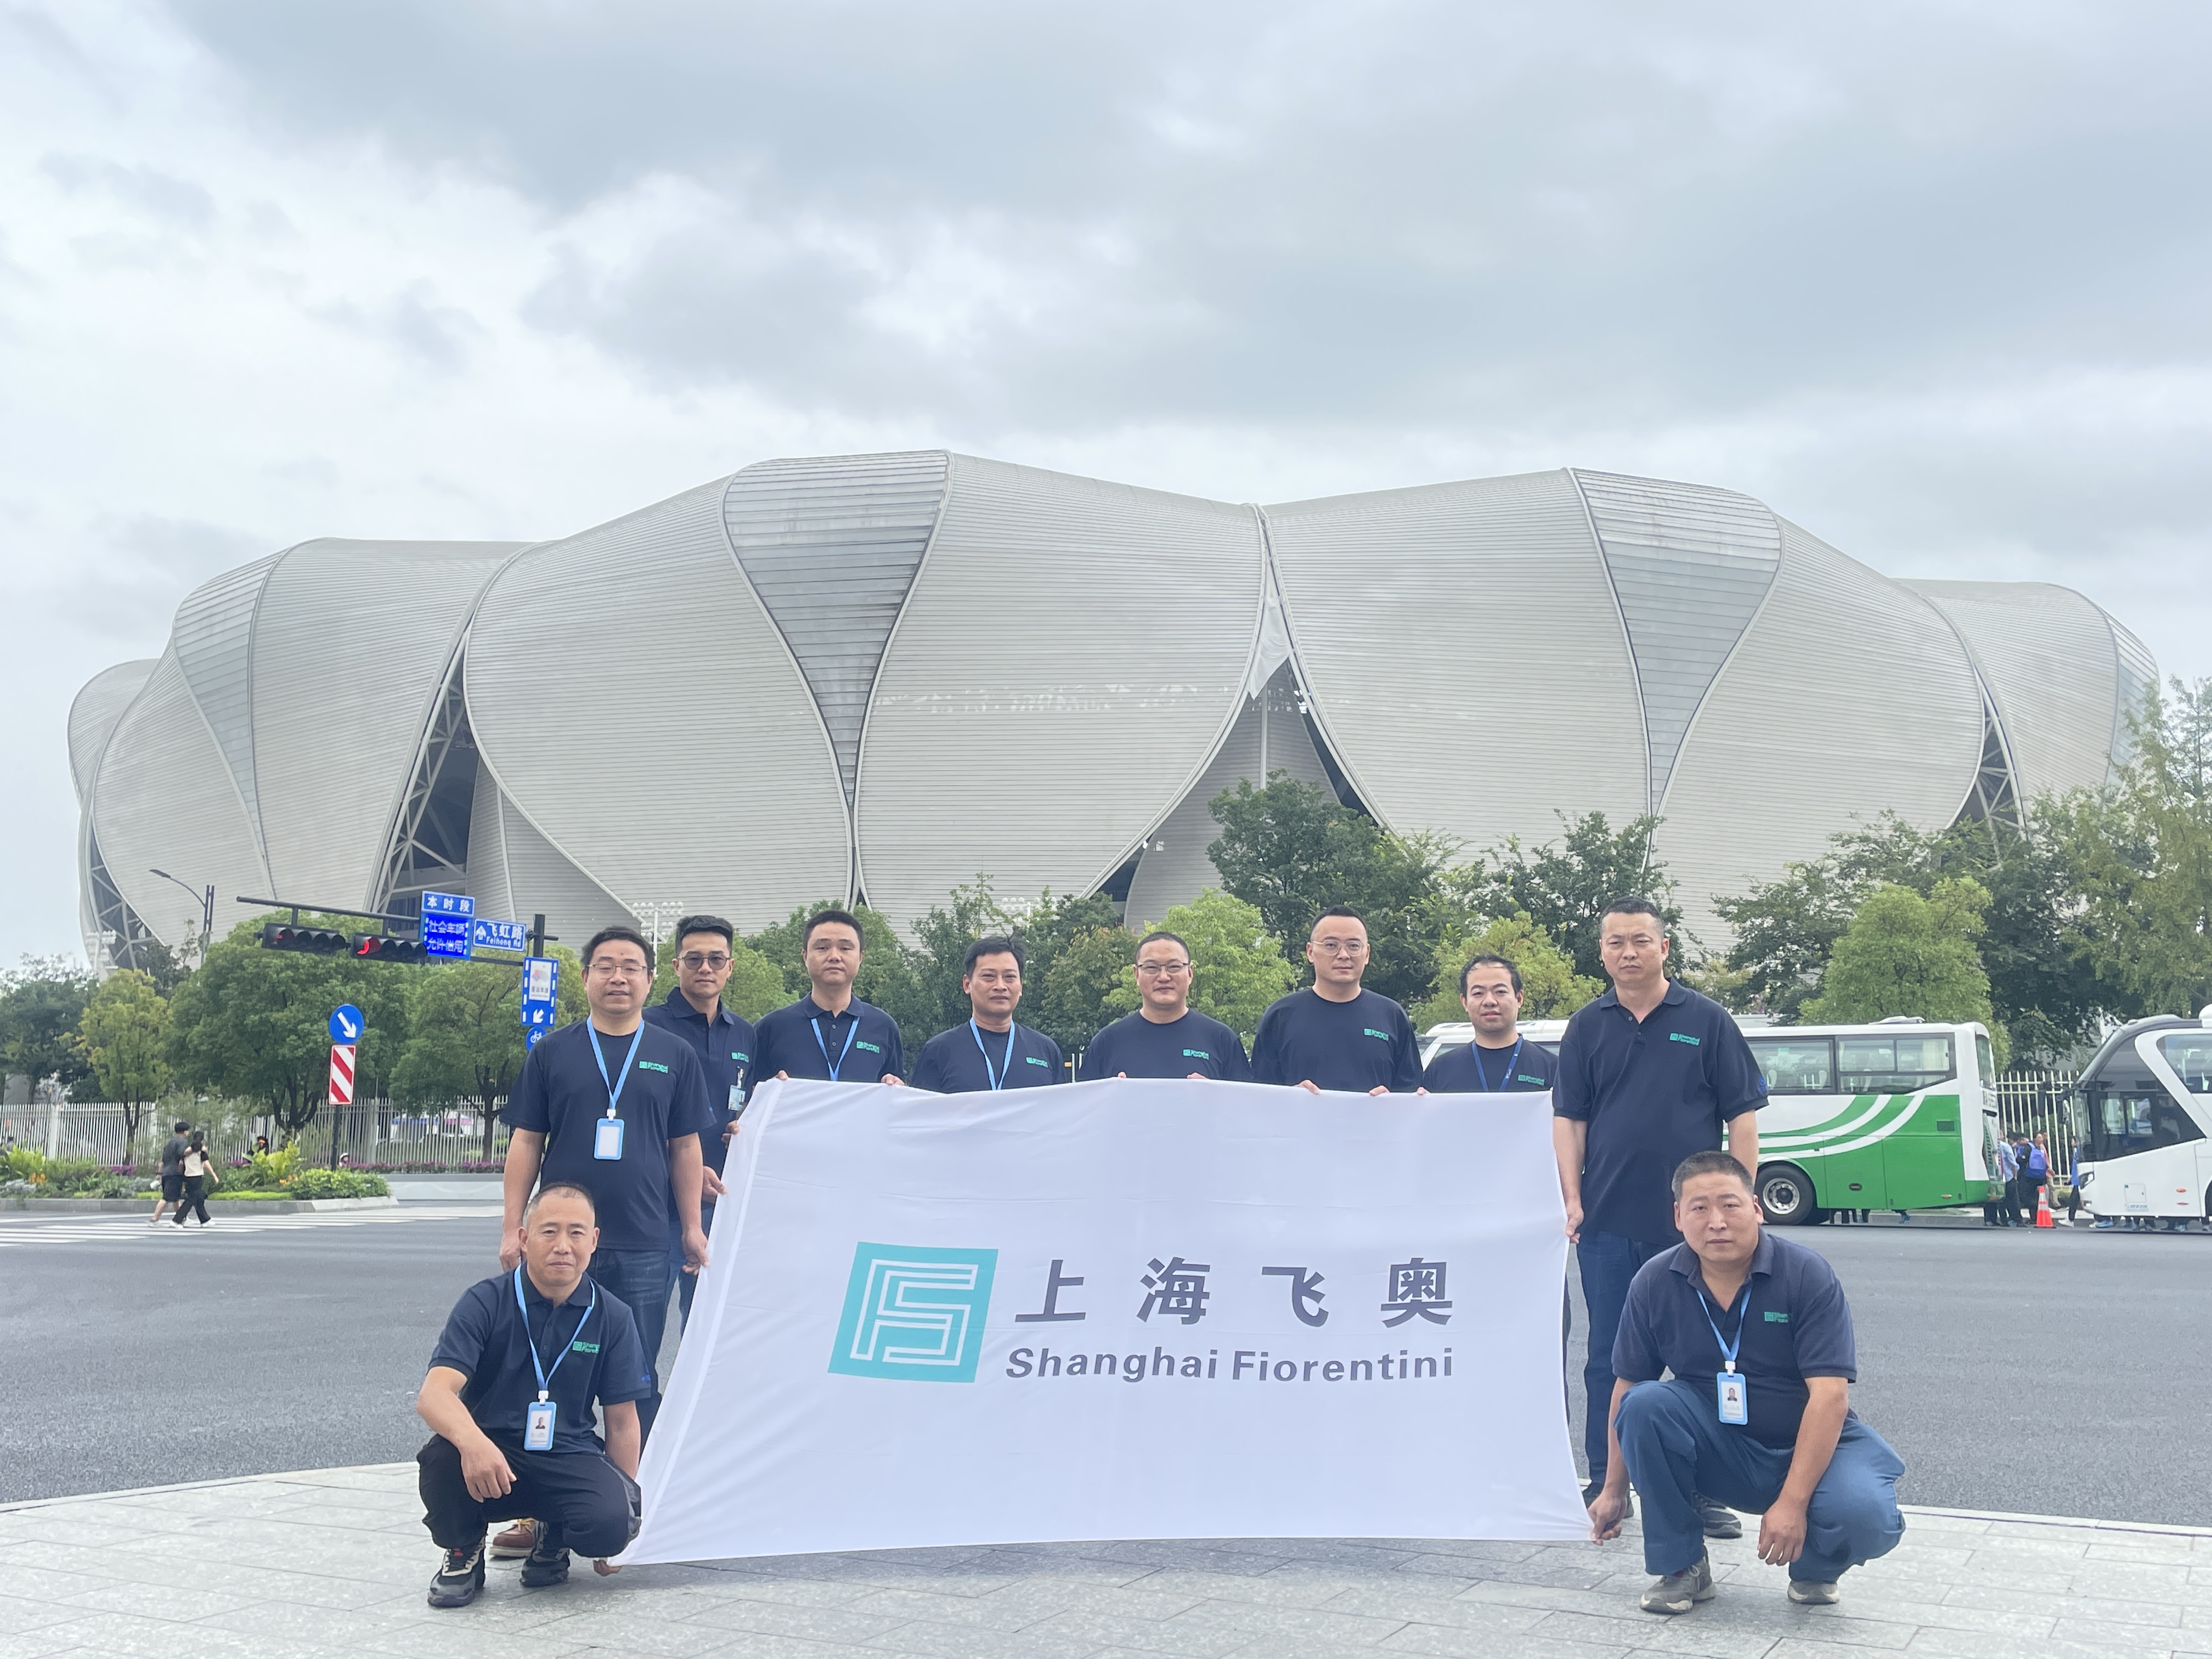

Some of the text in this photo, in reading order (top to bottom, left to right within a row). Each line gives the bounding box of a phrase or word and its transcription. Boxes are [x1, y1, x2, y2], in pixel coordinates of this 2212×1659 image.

[427, 895, 470, 913] 本时段
[428, 919, 465, 936] 社会车辆
[487, 923, 523, 940] 飞虹路
[486, 936, 511, 948] Feihong
[1015, 1257, 1452, 1328] 上海飞奥
[1006, 1346, 1452, 1383] Shanghai Fiorentini
